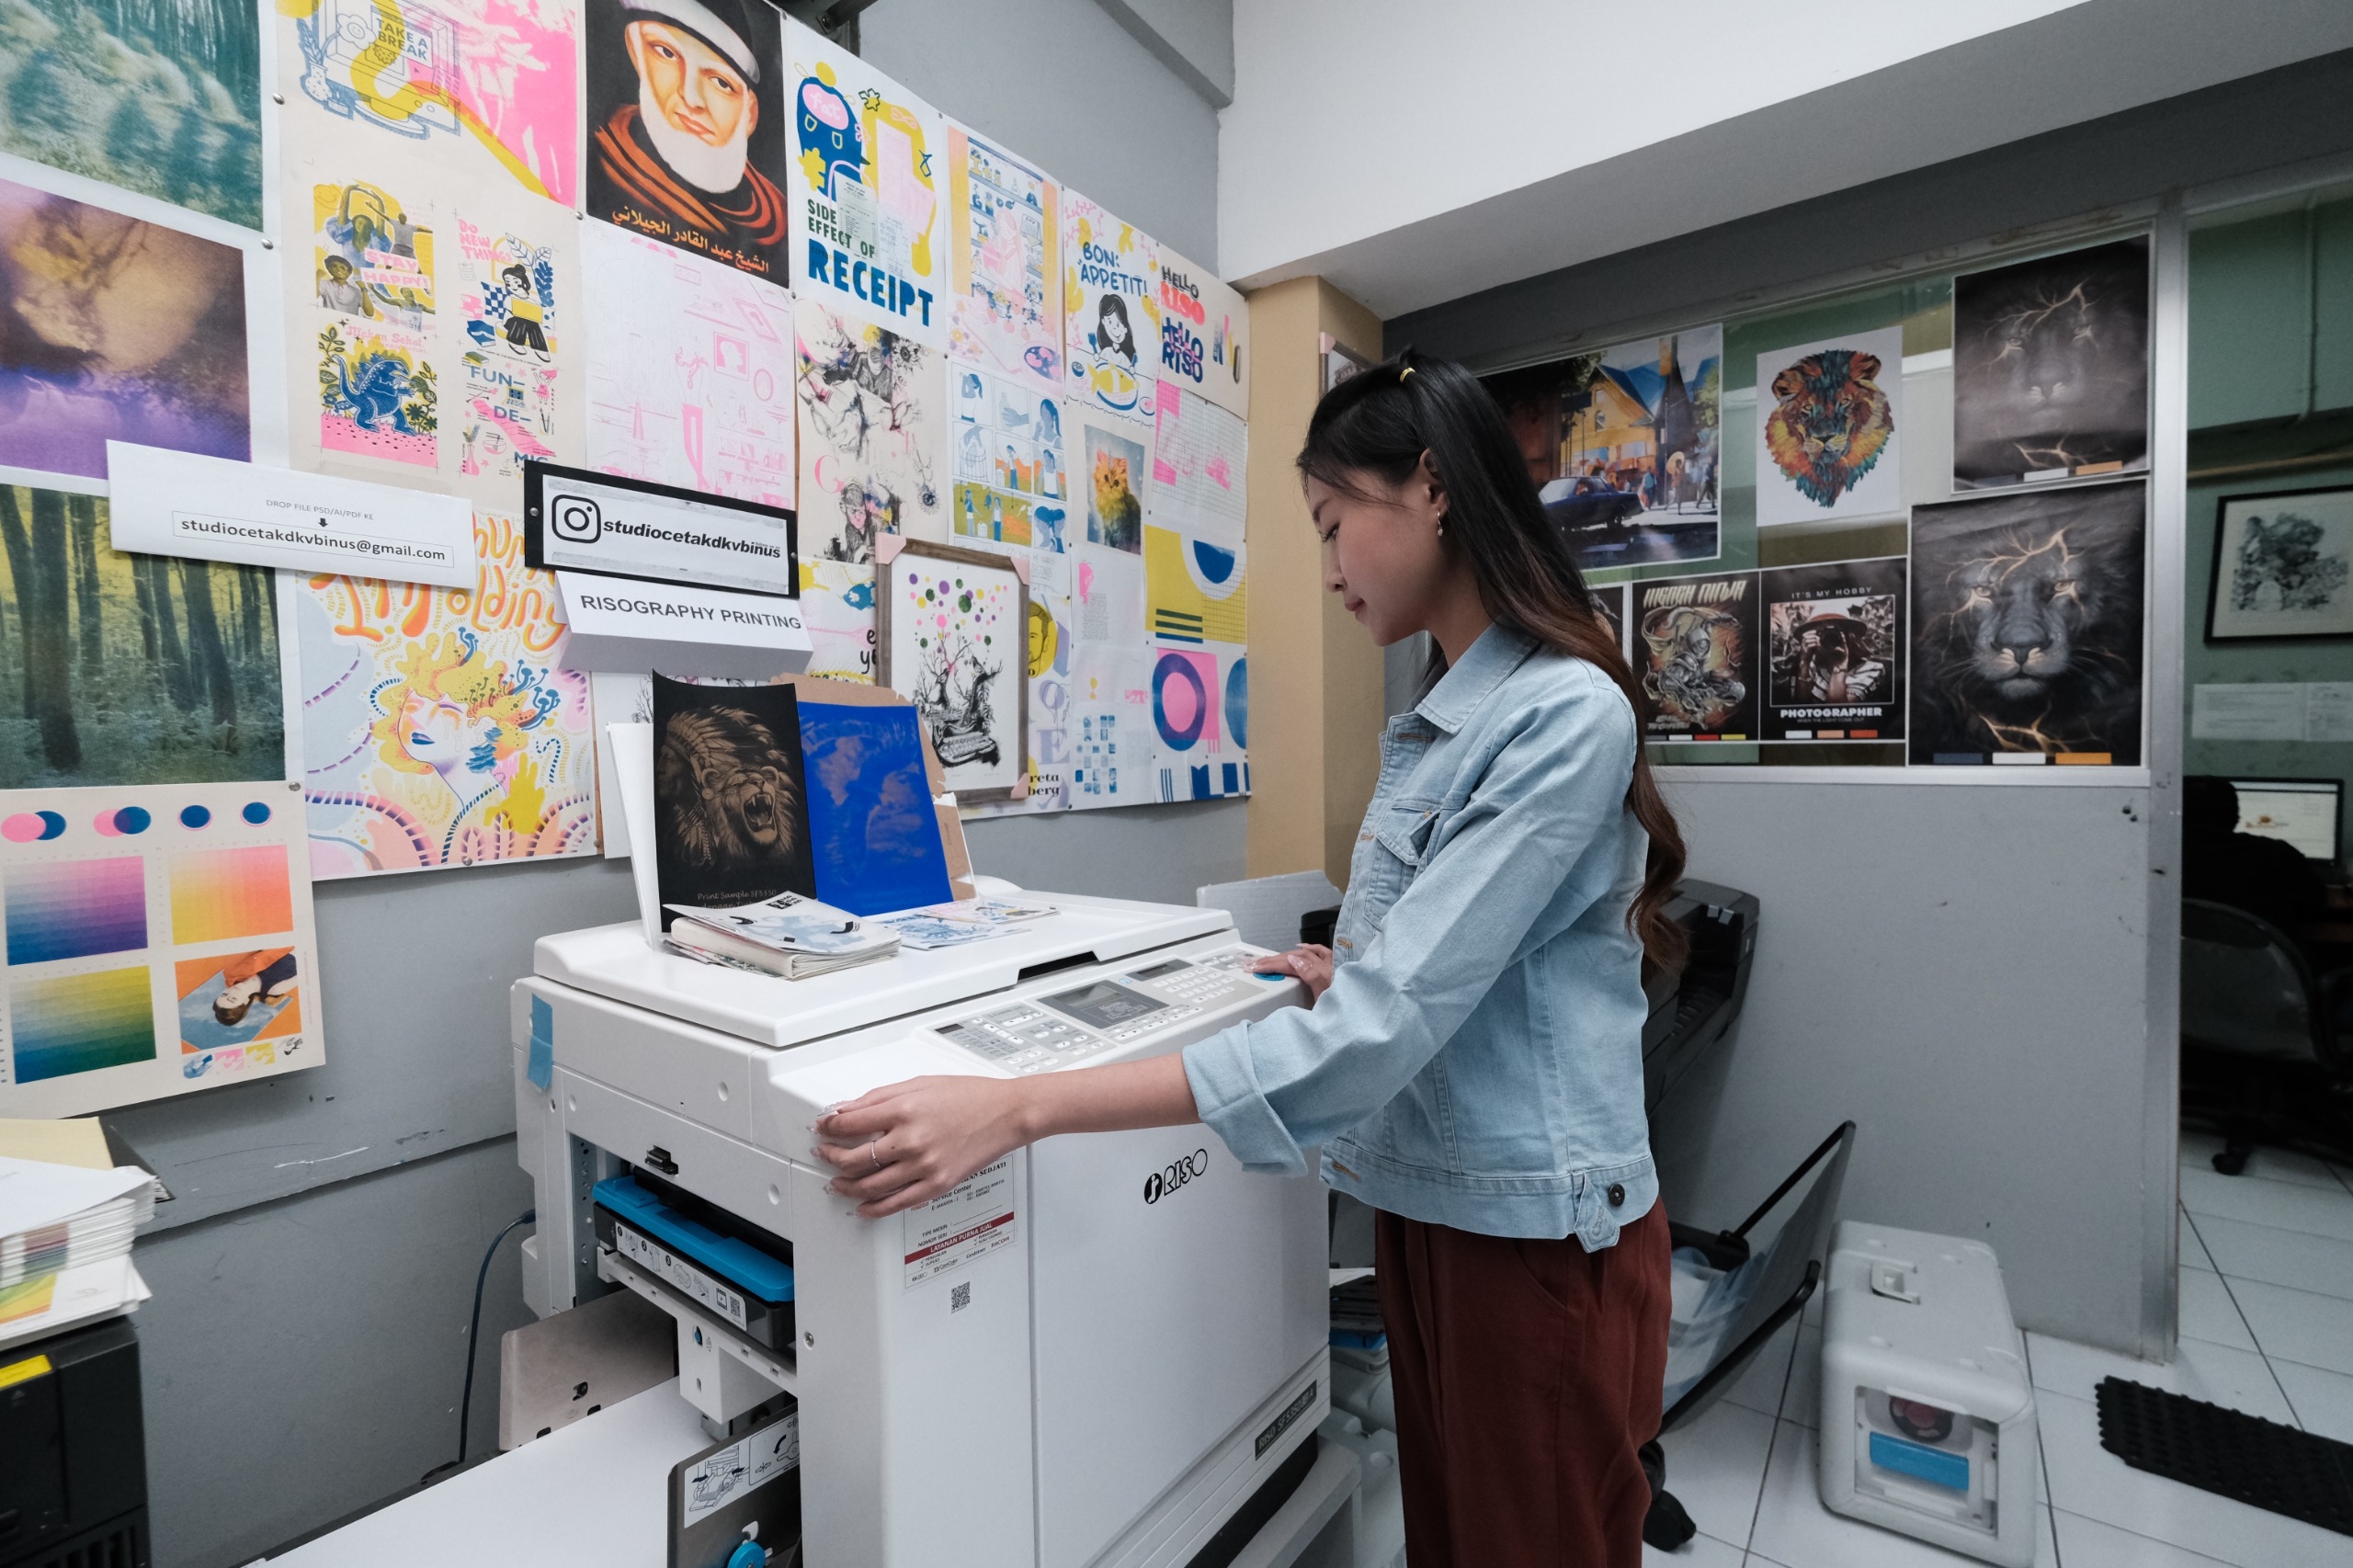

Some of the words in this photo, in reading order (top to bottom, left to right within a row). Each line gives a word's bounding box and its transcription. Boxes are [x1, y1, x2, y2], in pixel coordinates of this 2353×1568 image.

[376, 17, 415, 43] TAKE
[418, 38, 428, 50] A
[378, 30, 427, 61] BREAK
[807, 199, 837, 225] SIDE
[458, 219, 479, 234] DO
[808, 216, 853, 249] EFFECT
[860, 240, 876, 259] OF
[459, 232, 492, 247] NEW
[365, 250, 420, 274] STAY
[460, 245, 513, 262] THINGS
[710, 244, 734, 261] عبد
[363, 269, 430, 290] HAPPY!
[808, 238, 934, 327] RECEIPT
[1161, 265, 1199, 301] HELLO
[1161, 281, 1205, 325] RISO
[1162, 316, 1204, 363] HELLO
[1162, 341, 1204, 383] RISO
[266, 499, 292, 509] DROP
[294, 503, 312, 512] FILE
[313, 506, 362, 518] PSD/AI/PDF
[181, 519, 446, 562] studiocetakdkvbinus@gmail.com
[603, 518, 781, 558] studiocetakdkvbinus
[1698, 579, 1748, 605] NINJA
[1791, 591, 1812, 599] IT'S
[1836, 586, 1873, 596] HOBBY
[580, 595, 715, 621] RISOGRAPHY
[721, 609, 802, 630] PRINTING
[1779, 707, 1882, 719] PHOTOGRAPHER
[1029, 773, 1059, 783] reta
[1028, 786, 1060, 798] berg
[698, 892, 720, 900] Print
[721, 890, 750, 900] Sample
[979, 1161, 1006, 1176] SEDJATI
[1164, 1148, 1209, 1197] RISO
[953, 1184, 972, 1195] Center
[930, 1237, 958, 1253] LAYANAN
[959, 1228, 979, 1242] PURNA
[979, 1221, 993, 1233] JUAL
[938, 1232, 948, 1241] SERI
[991, 1235, 1010, 1248] RICOH
